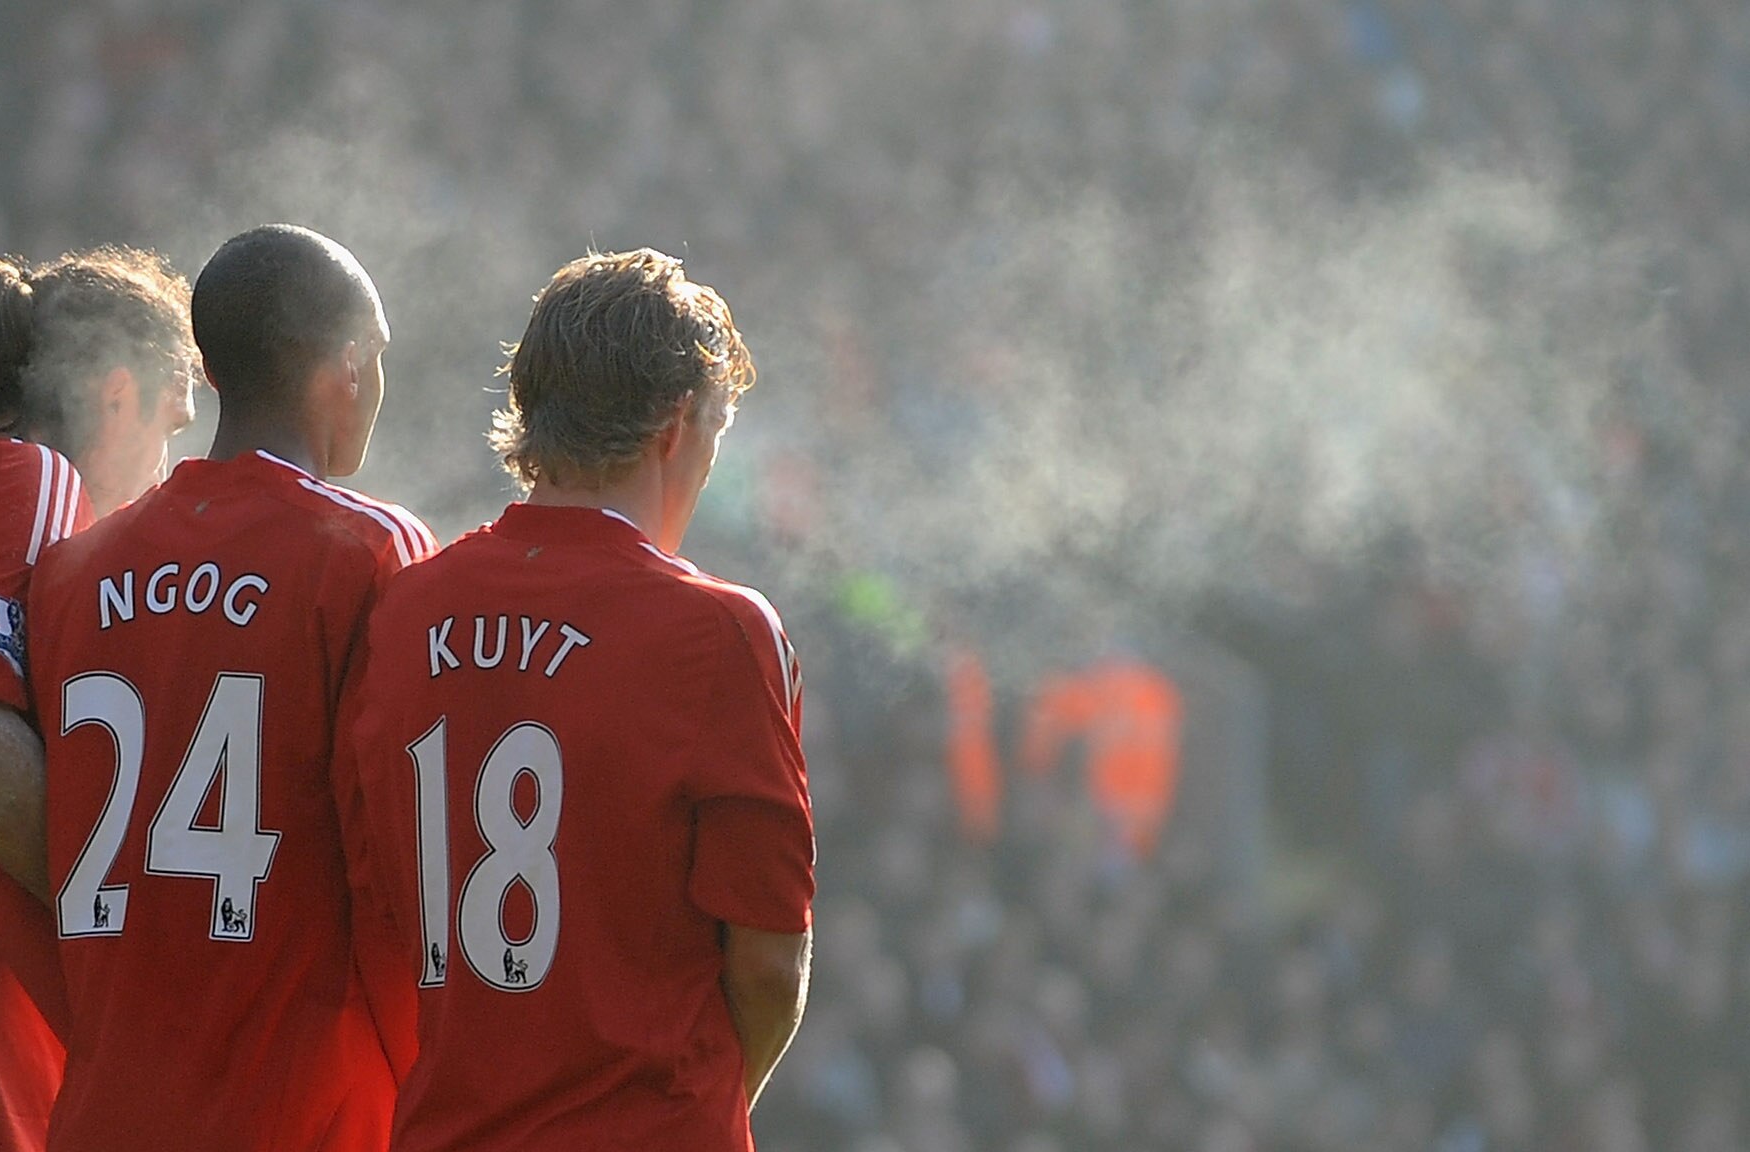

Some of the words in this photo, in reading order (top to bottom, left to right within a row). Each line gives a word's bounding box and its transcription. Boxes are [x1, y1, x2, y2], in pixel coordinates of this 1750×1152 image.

[98, 562, 270, 630] NGOG
[428, 615, 592, 678] KUYT
[56, 670, 283, 942] 24
[405, 714, 564, 993] 18
